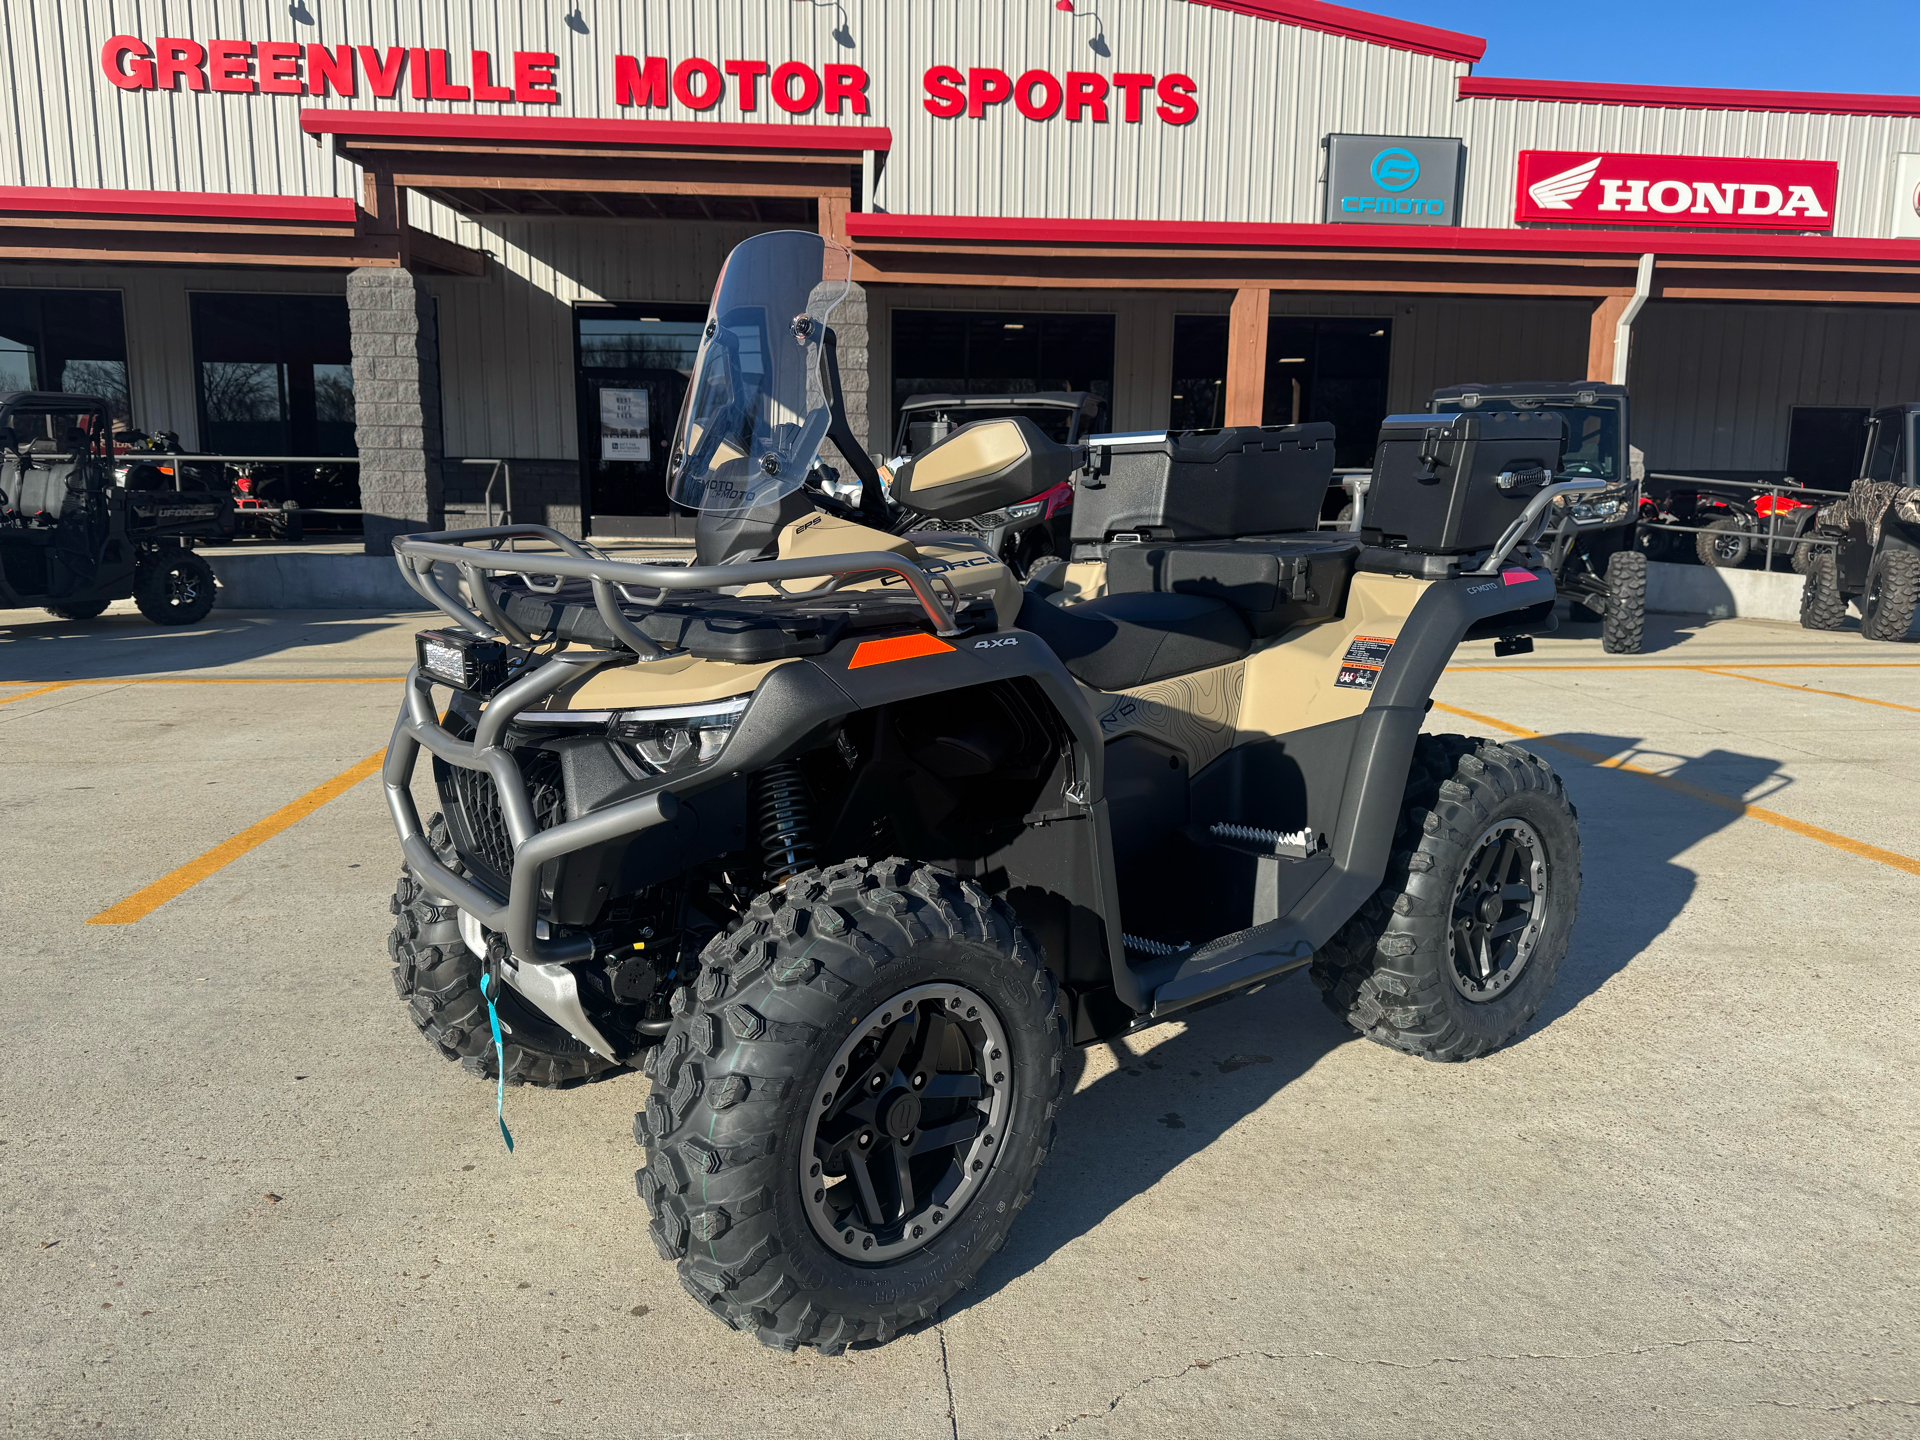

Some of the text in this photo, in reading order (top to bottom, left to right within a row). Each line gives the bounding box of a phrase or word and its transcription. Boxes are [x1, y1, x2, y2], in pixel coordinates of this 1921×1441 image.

[101, 35, 1198, 126] GREENVILLE MOTOR SPORTS
[1341, 196, 1445, 216] CFMOTO
[1597, 178, 1829, 218] HONDA
[158, 509, 206, 518] UFORCE
[796, 516, 822, 535] EPS
[1466, 582, 1498, 595] CFMOTO
